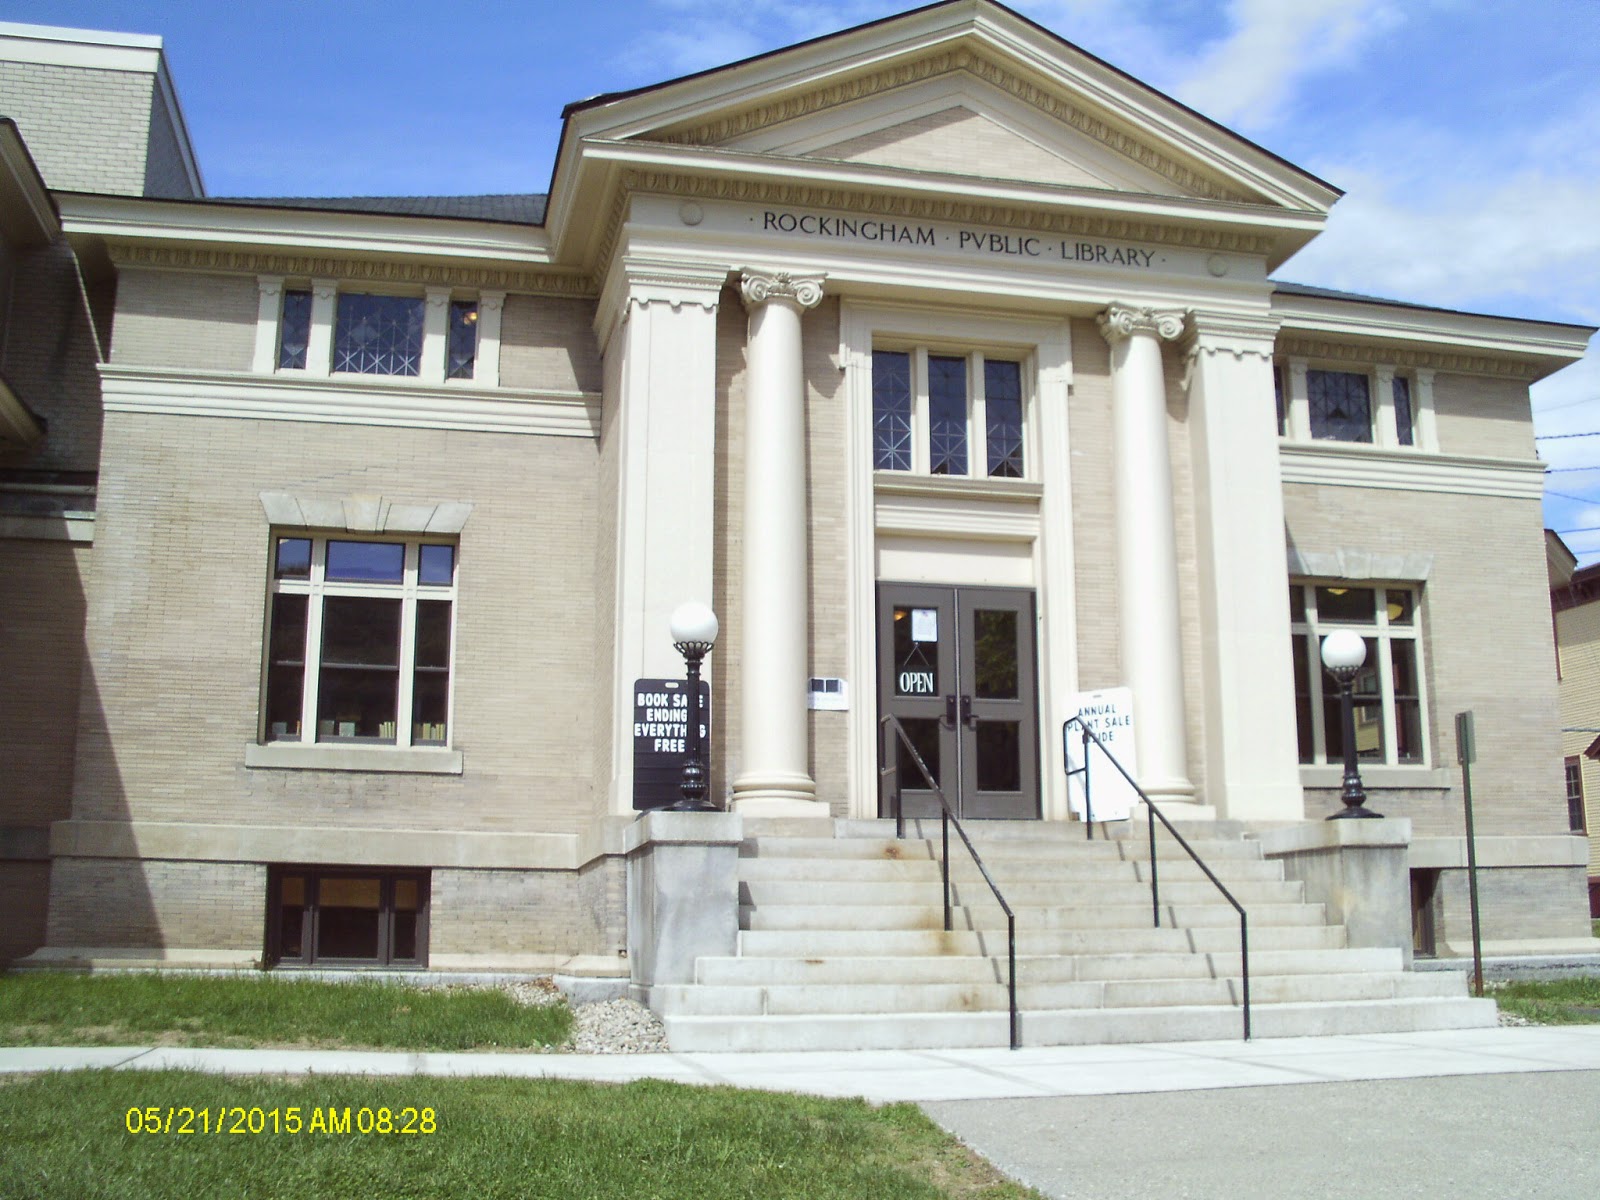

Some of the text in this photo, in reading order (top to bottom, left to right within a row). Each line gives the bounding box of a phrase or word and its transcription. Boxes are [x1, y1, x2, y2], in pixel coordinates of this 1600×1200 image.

[763, 210, 1155, 267] ROCKINGHAM PVBLIC LIBRARY
[900, 672, 934, 693] OPEN
[638, 693, 703, 708] BOOK SA
[647, 708, 687, 722] ENDING
[1079, 704, 1116, 717] ANNUAL
[1105, 715, 1131, 727] SALE
[635, 723, 706, 738] EVERYTHG
[654, 739, 686, 753] FREE
